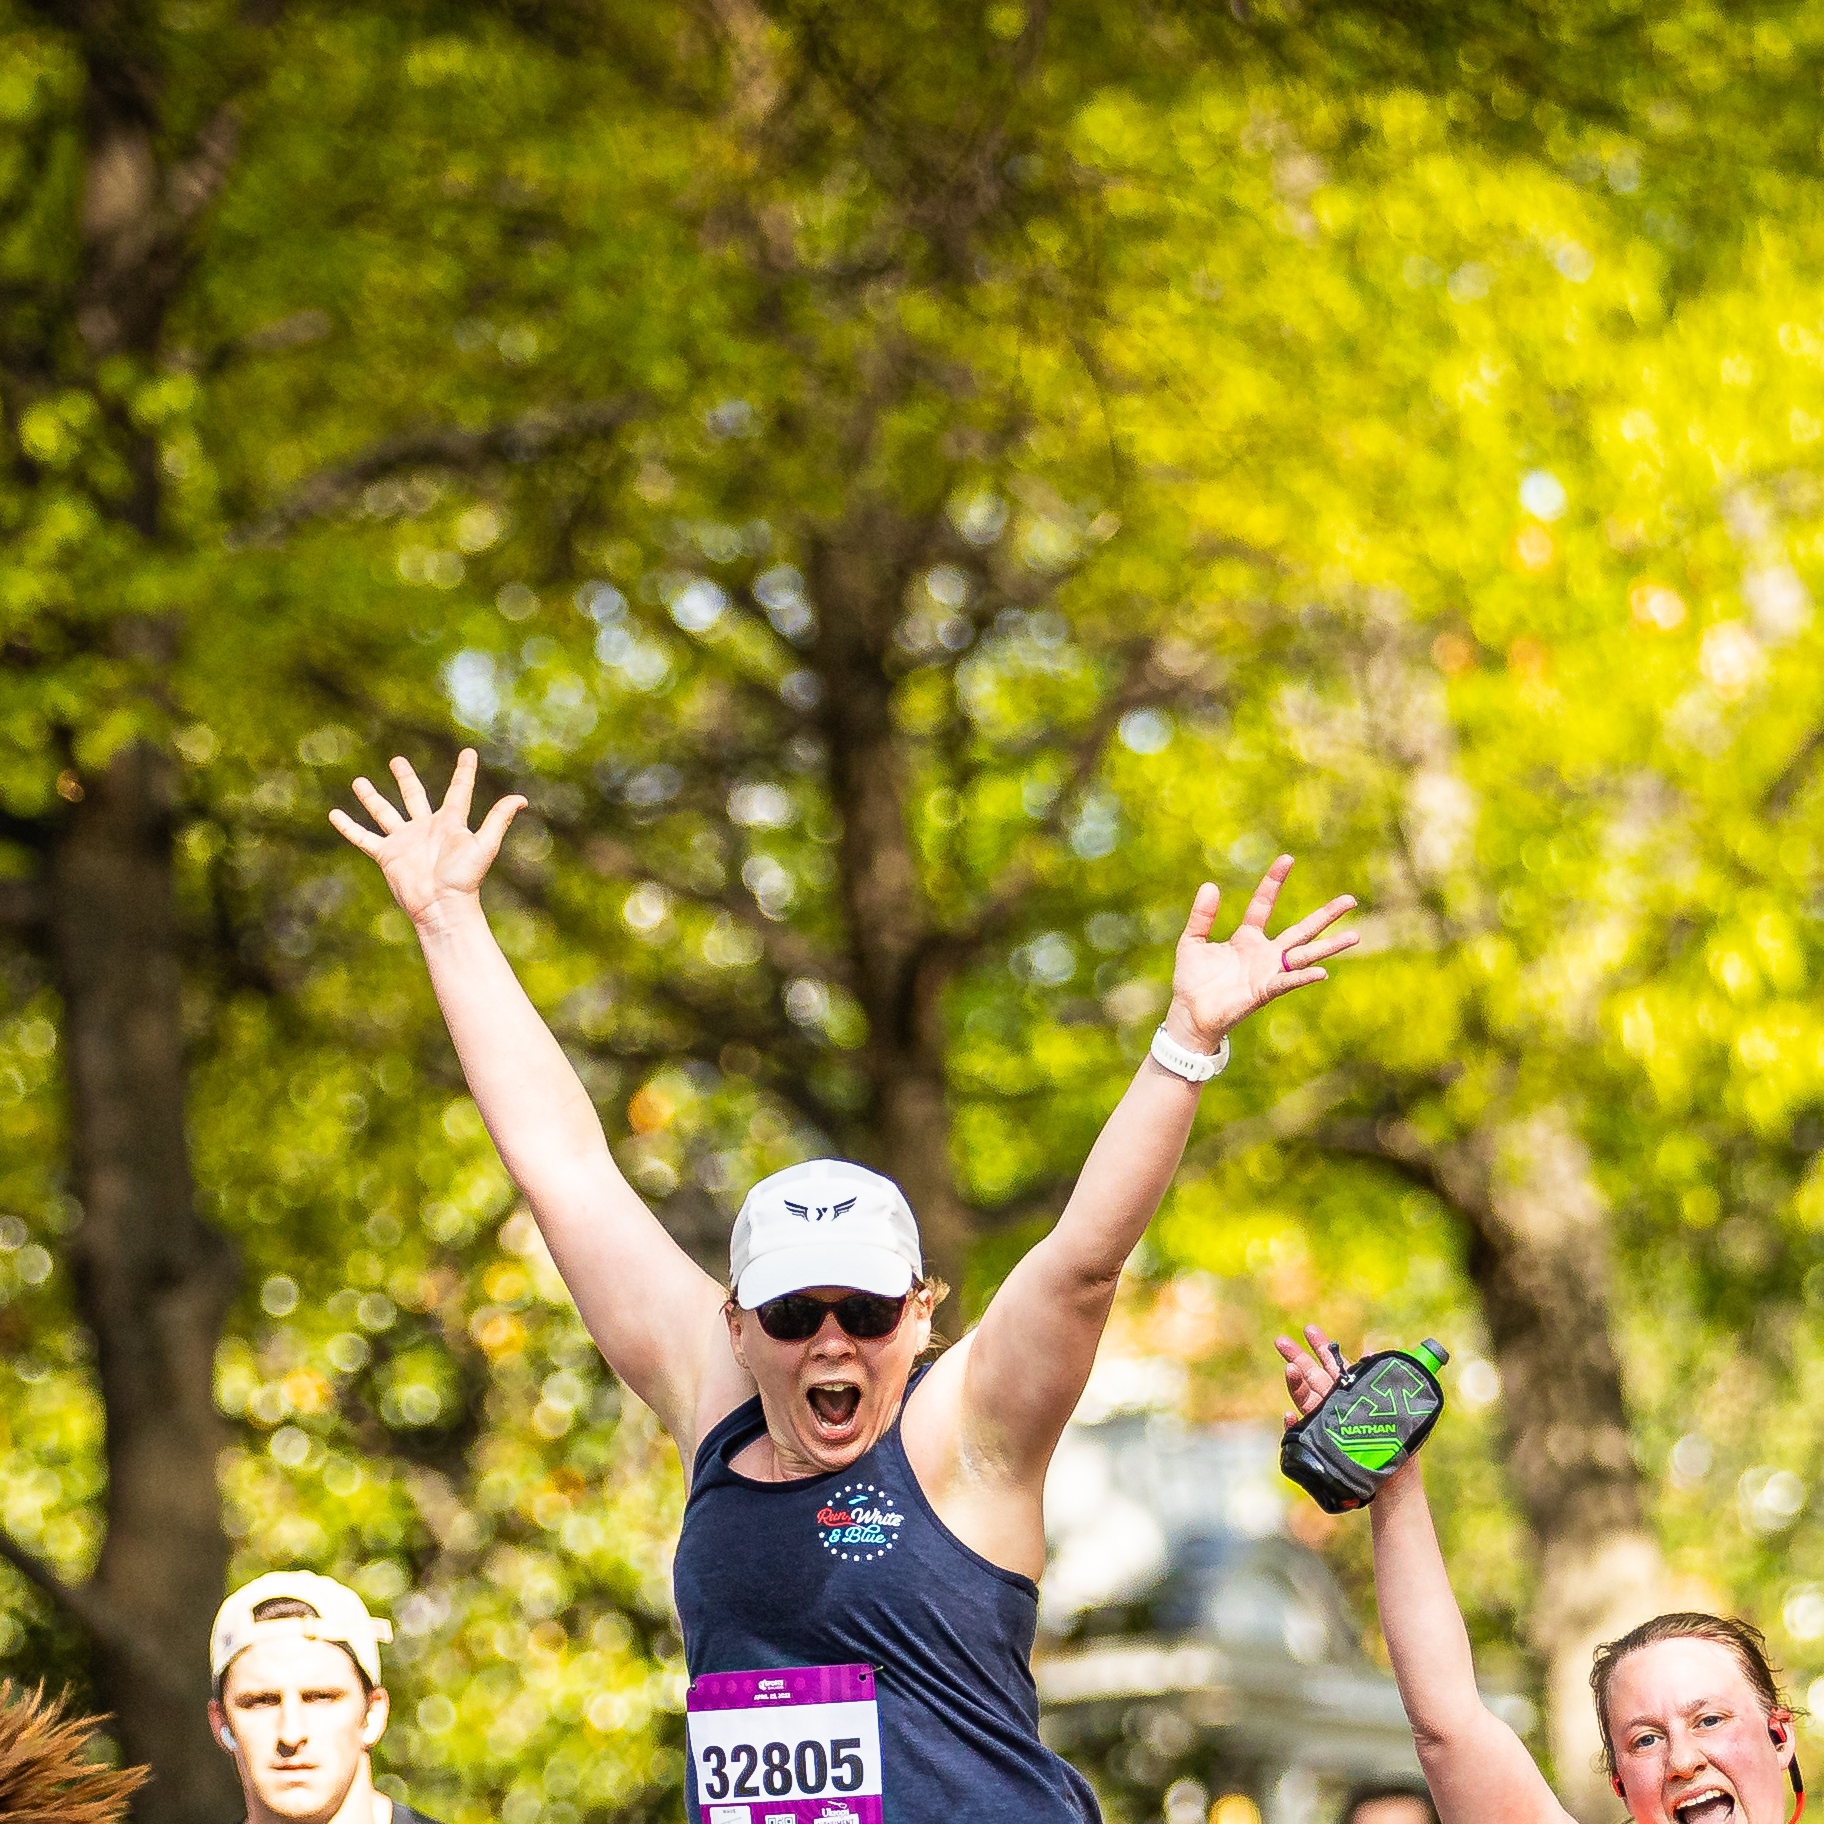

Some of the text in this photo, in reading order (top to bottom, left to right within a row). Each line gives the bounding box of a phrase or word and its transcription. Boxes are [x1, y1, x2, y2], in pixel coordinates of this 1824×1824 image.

[1340, 1423, 1396, 1436] NATHAN
[851, 1507, 904, 1526] White
[829, 1524, 886, 1543] & Blue
[702, 1737, 864, 1799] 32805
